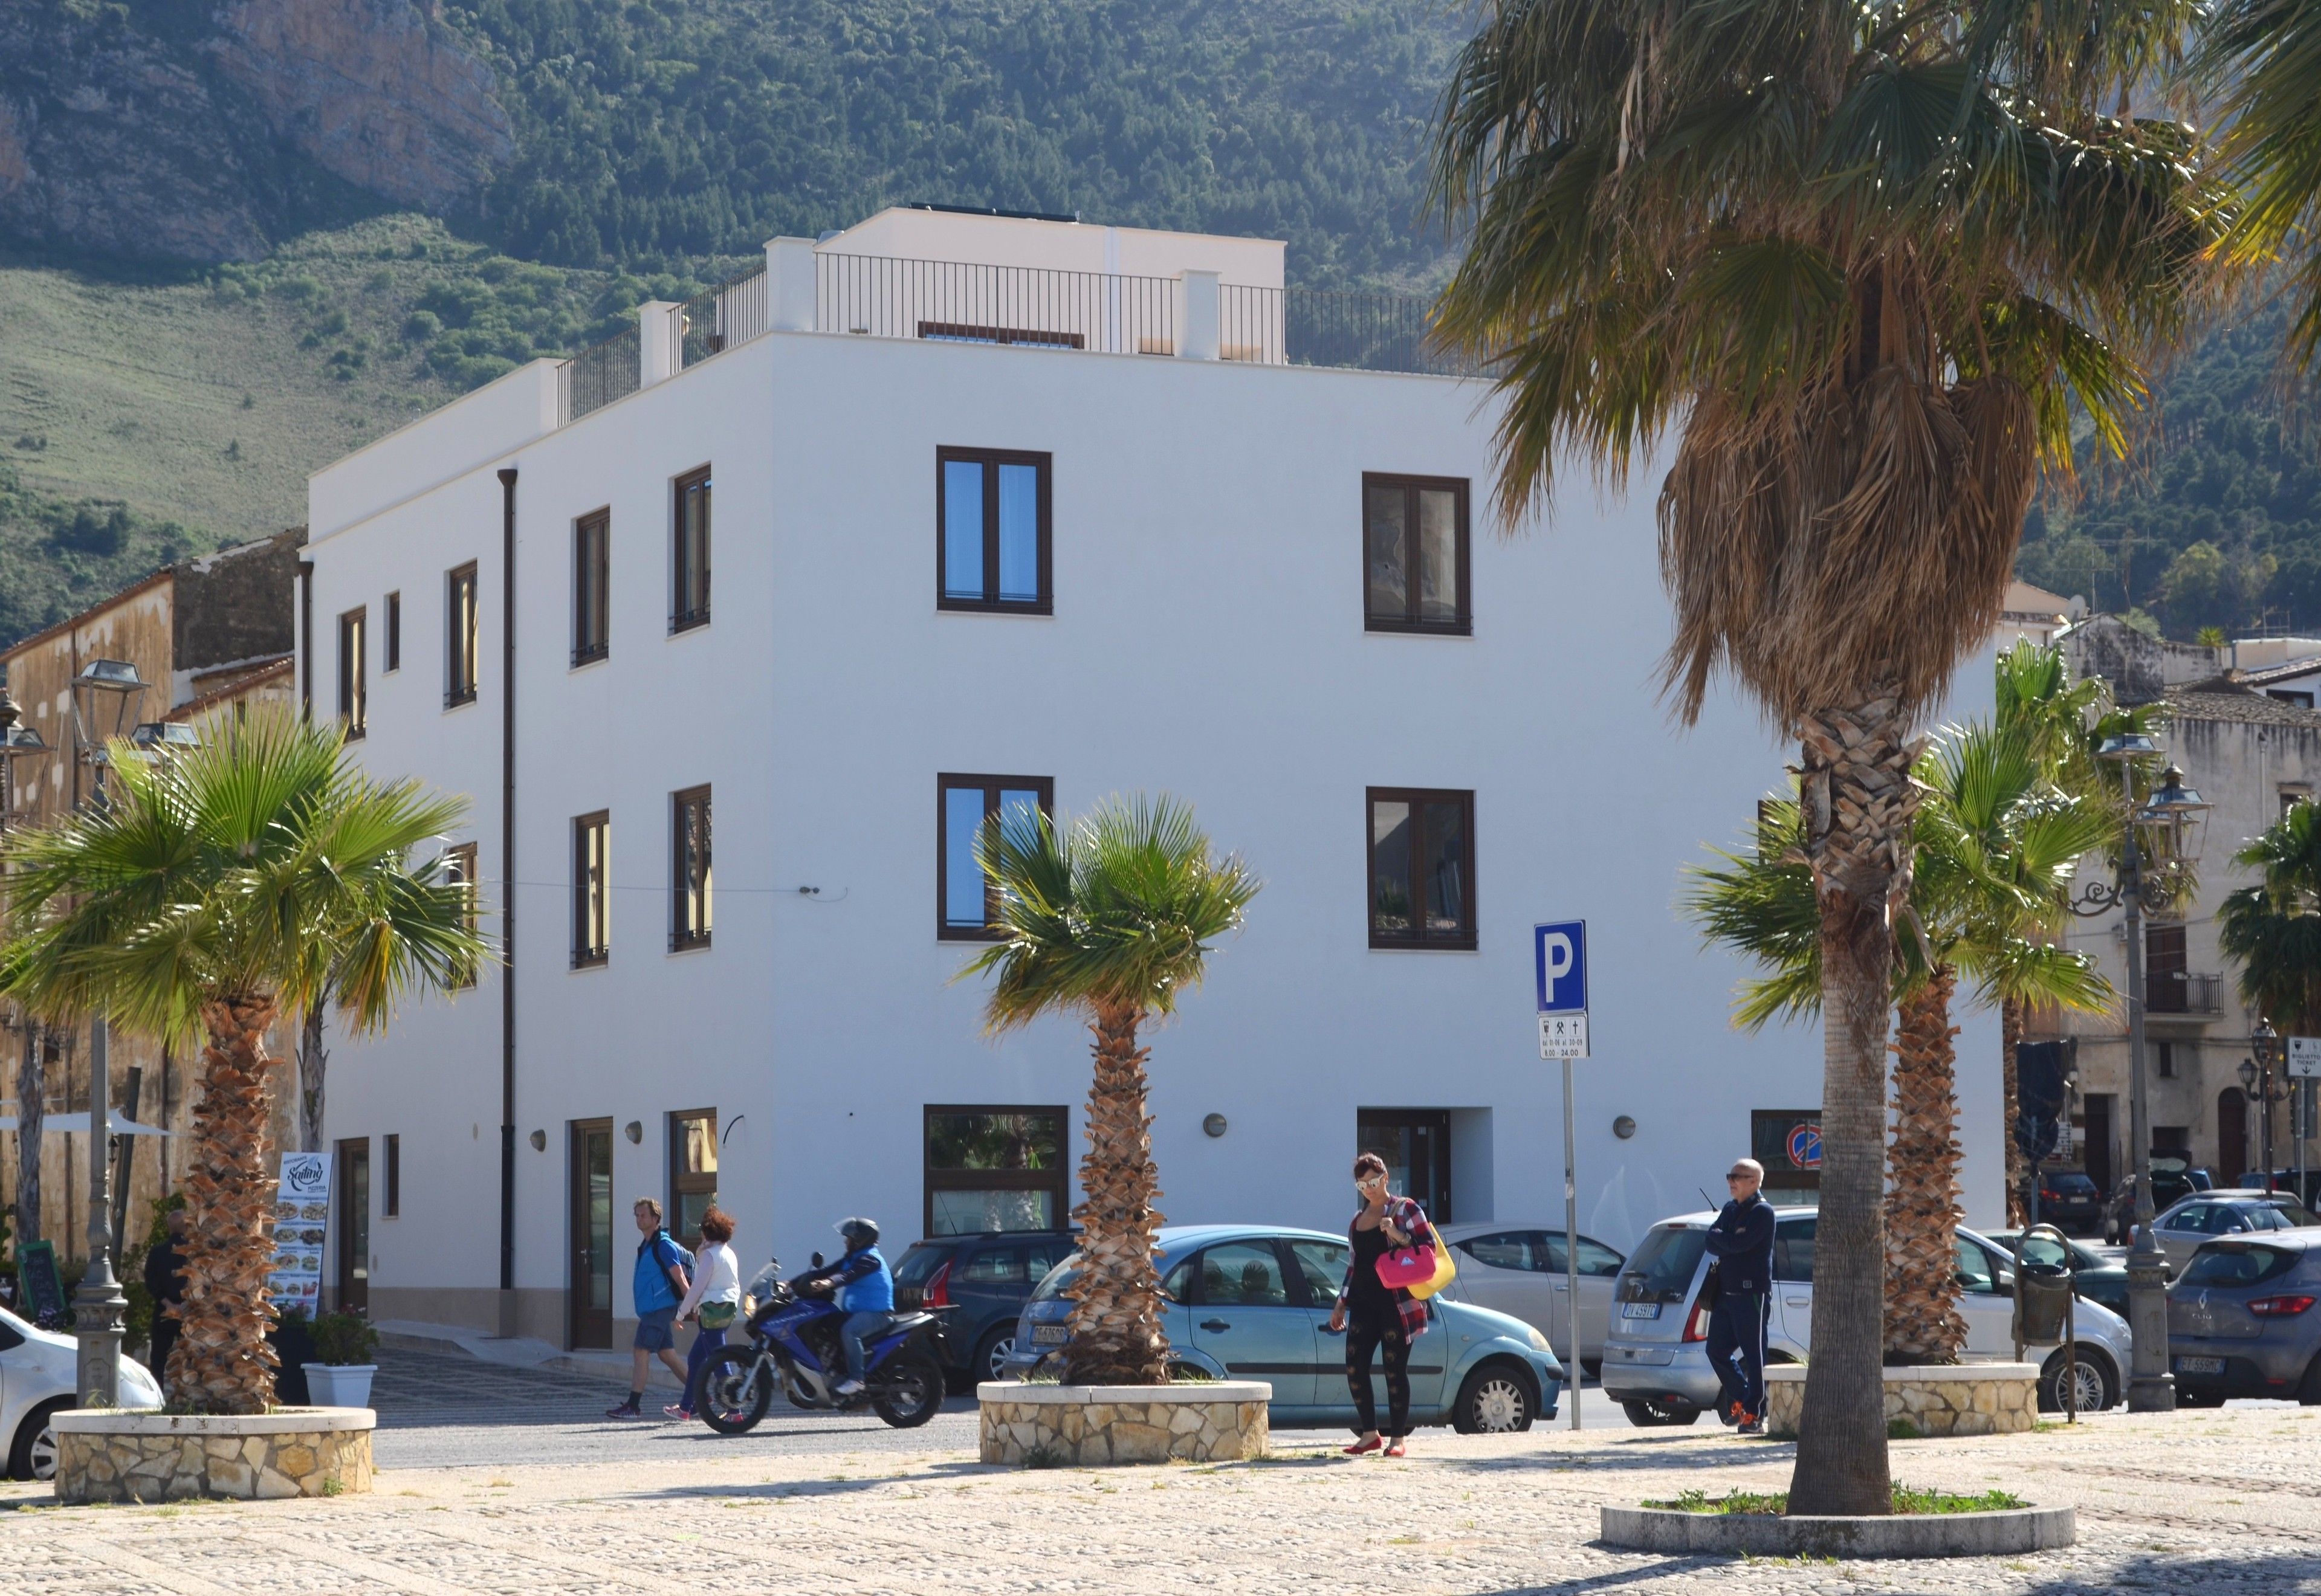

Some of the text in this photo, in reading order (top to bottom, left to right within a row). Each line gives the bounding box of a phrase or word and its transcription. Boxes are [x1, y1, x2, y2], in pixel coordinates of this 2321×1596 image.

[1544, 932, 1573, 1004] P
[283, 1155, 307, 1165] RISTORANTE
[287, 1166, 323, 1183] Sailing
